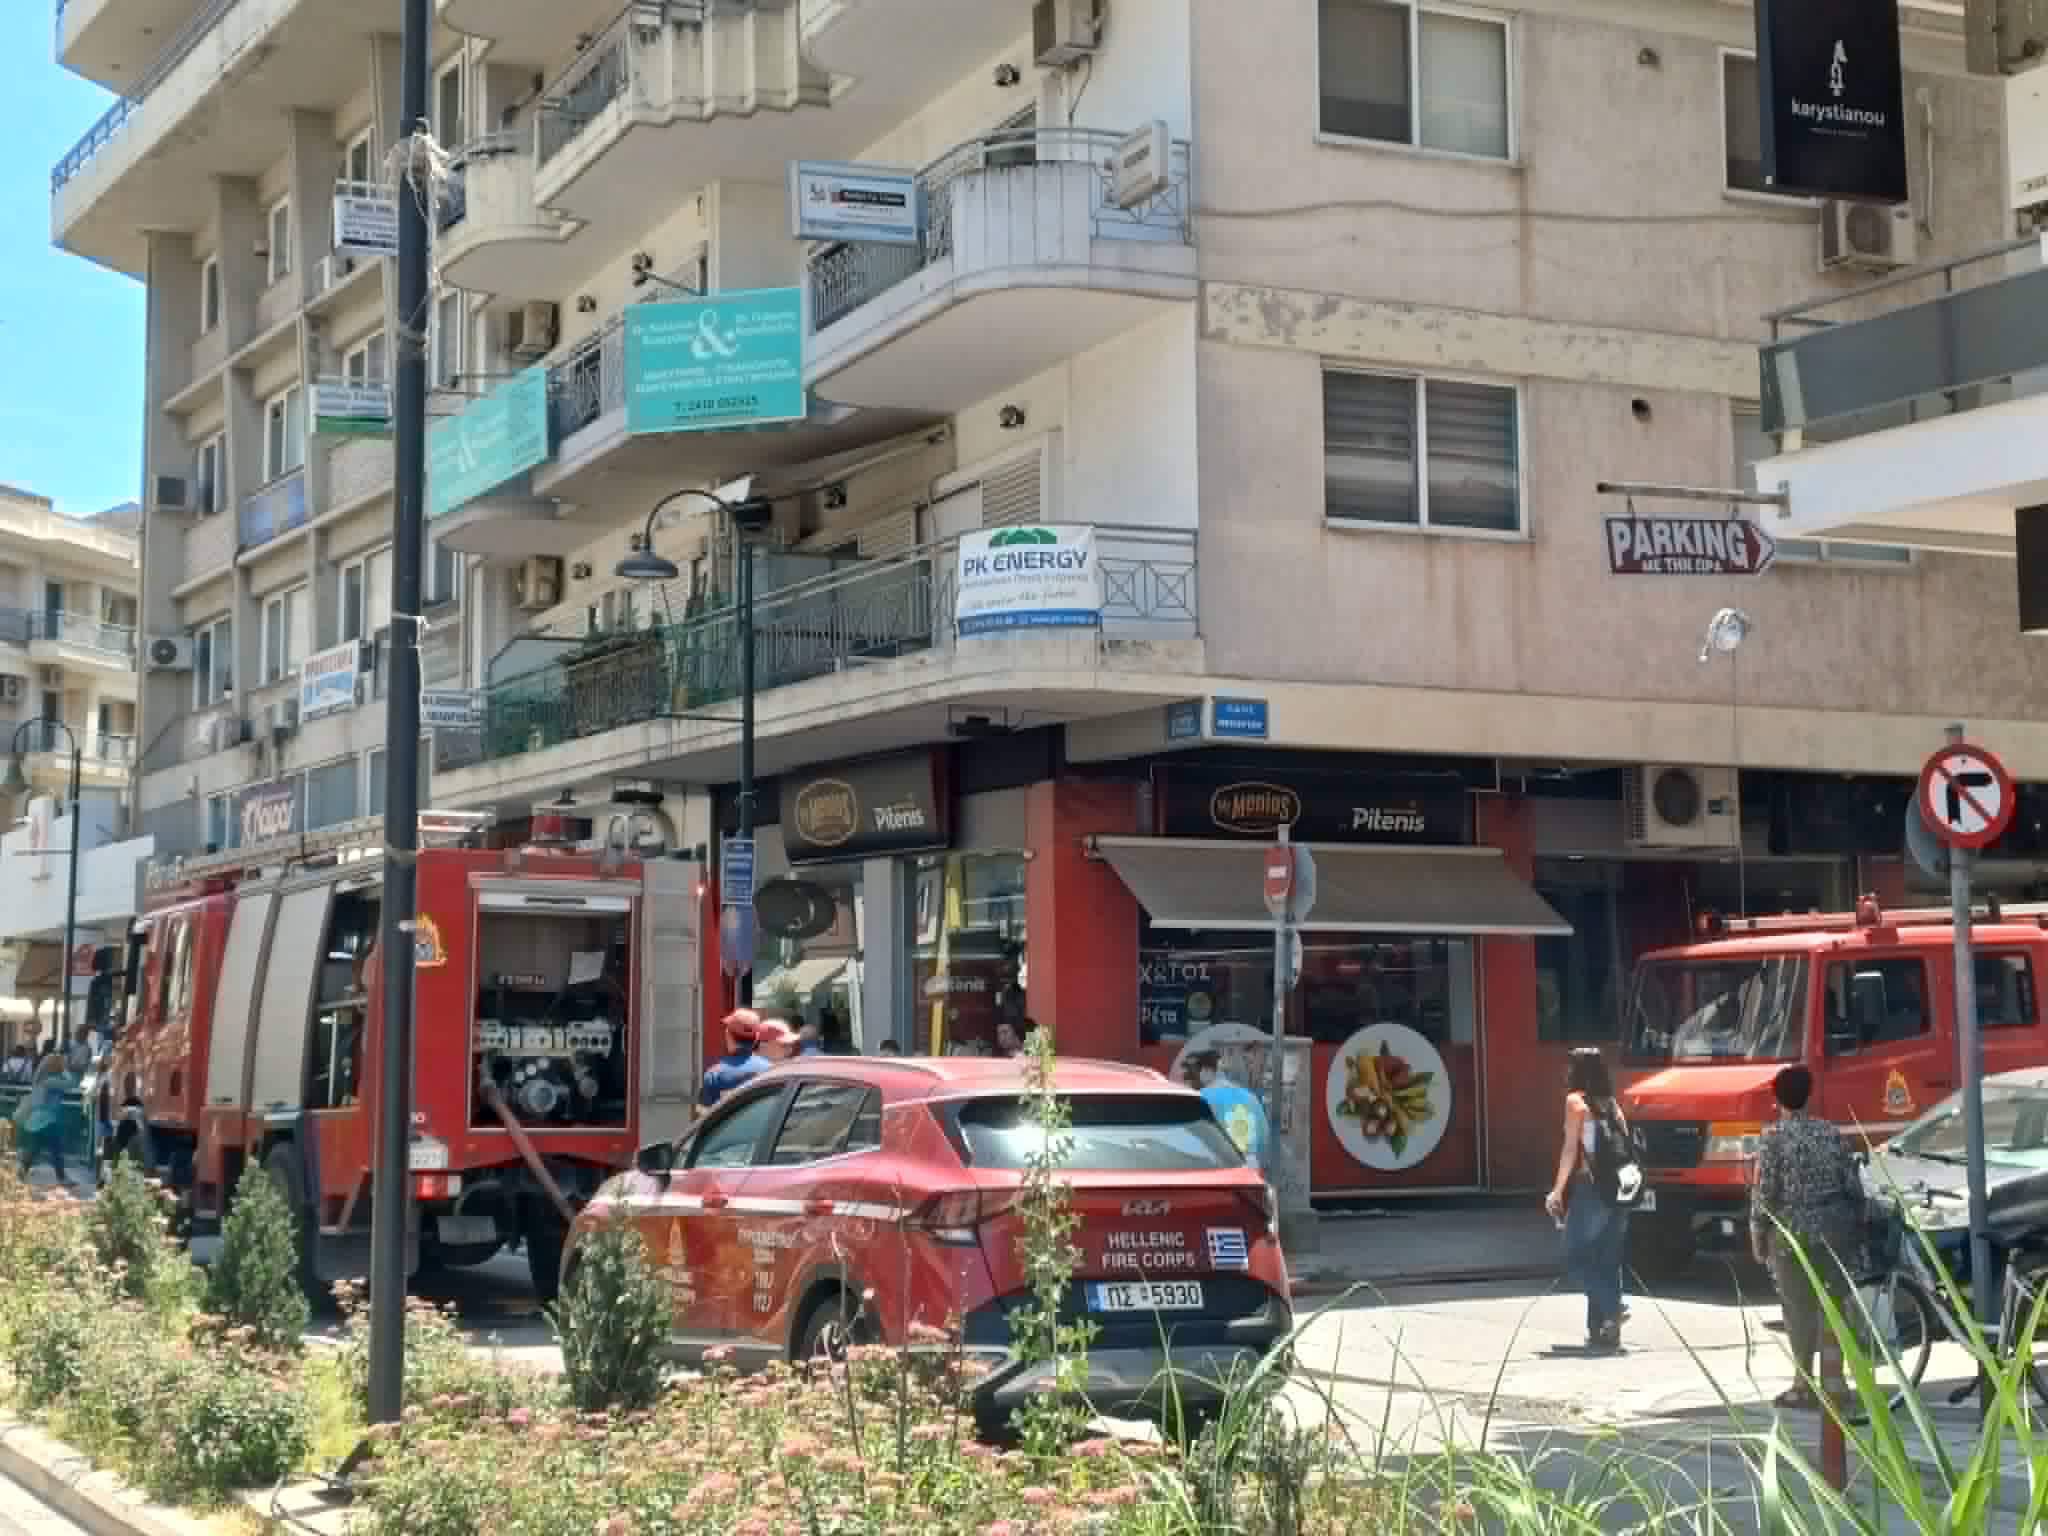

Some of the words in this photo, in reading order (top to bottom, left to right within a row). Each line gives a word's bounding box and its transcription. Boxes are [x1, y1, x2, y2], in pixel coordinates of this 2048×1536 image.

[1611, 521, 1748, 568] PARKING
[963, 555, 988, 577] PK
[993, 548, 1088, 573] ENERGY
[1352, 807, 1425, 832] Pitenis
[1107, 1231, 1184, 1248] HELLENIC
[1102, 1252, 1137, 1269] FIRE
[1142, 1252, 1196, 1268] CORPS
[1151, 1284, 1199, 1305] 5930
